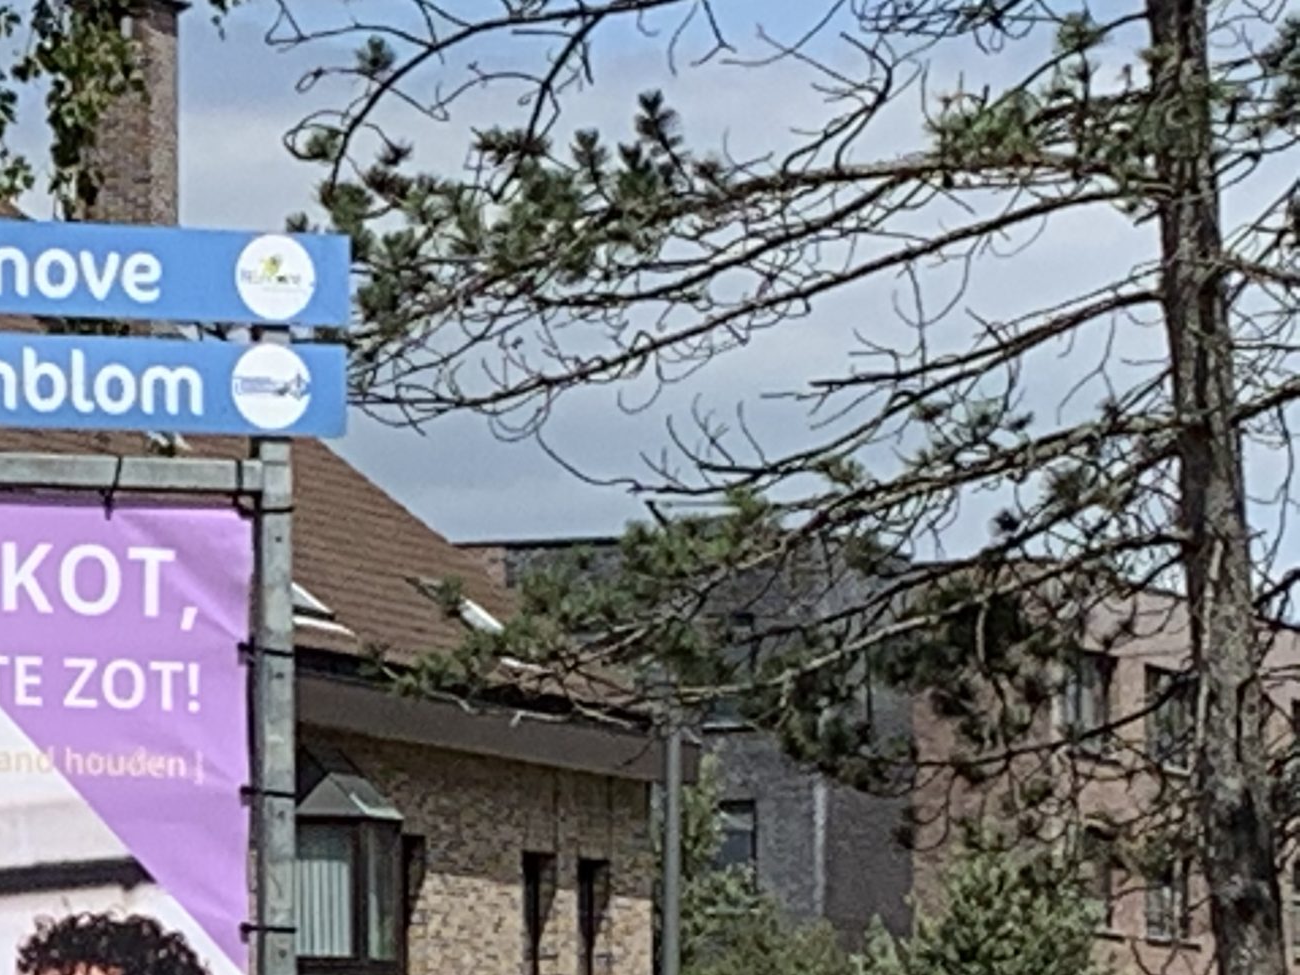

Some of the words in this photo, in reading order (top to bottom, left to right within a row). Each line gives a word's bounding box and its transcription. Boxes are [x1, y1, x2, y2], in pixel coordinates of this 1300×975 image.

[1, 541, 199, 631] KOT,
[63, 658, 200, 712] ZOT!
[65, 744, 186, 779] houden
